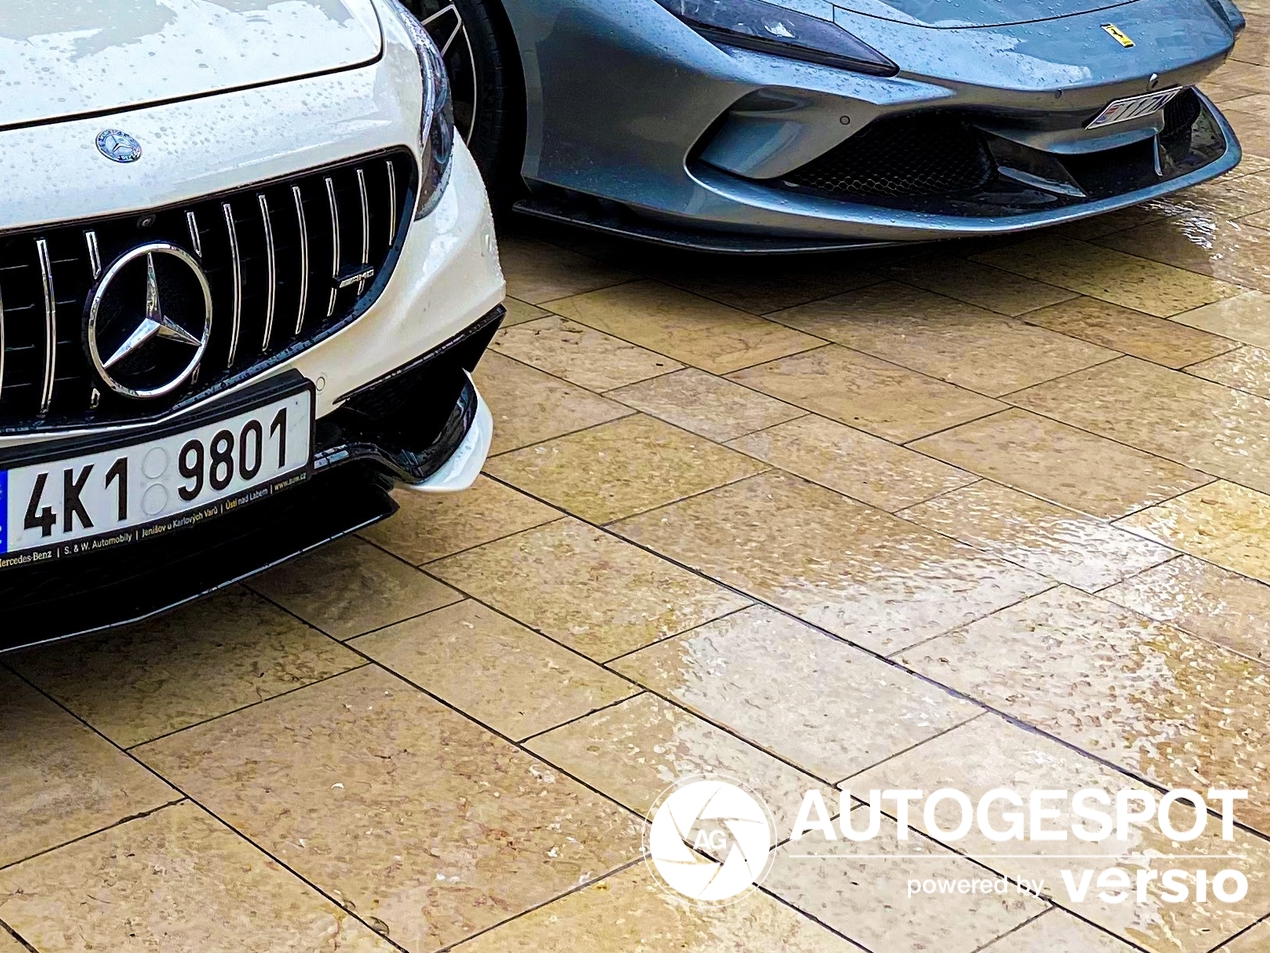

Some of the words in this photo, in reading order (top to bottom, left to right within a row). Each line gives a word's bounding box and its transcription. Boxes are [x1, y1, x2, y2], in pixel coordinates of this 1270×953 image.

[23, 457, 129, 538] 4K1
[177, 408, 288, 501] 9801
[73, 544, 79, 553] &
[91, 532, 132, 549] Automobily
